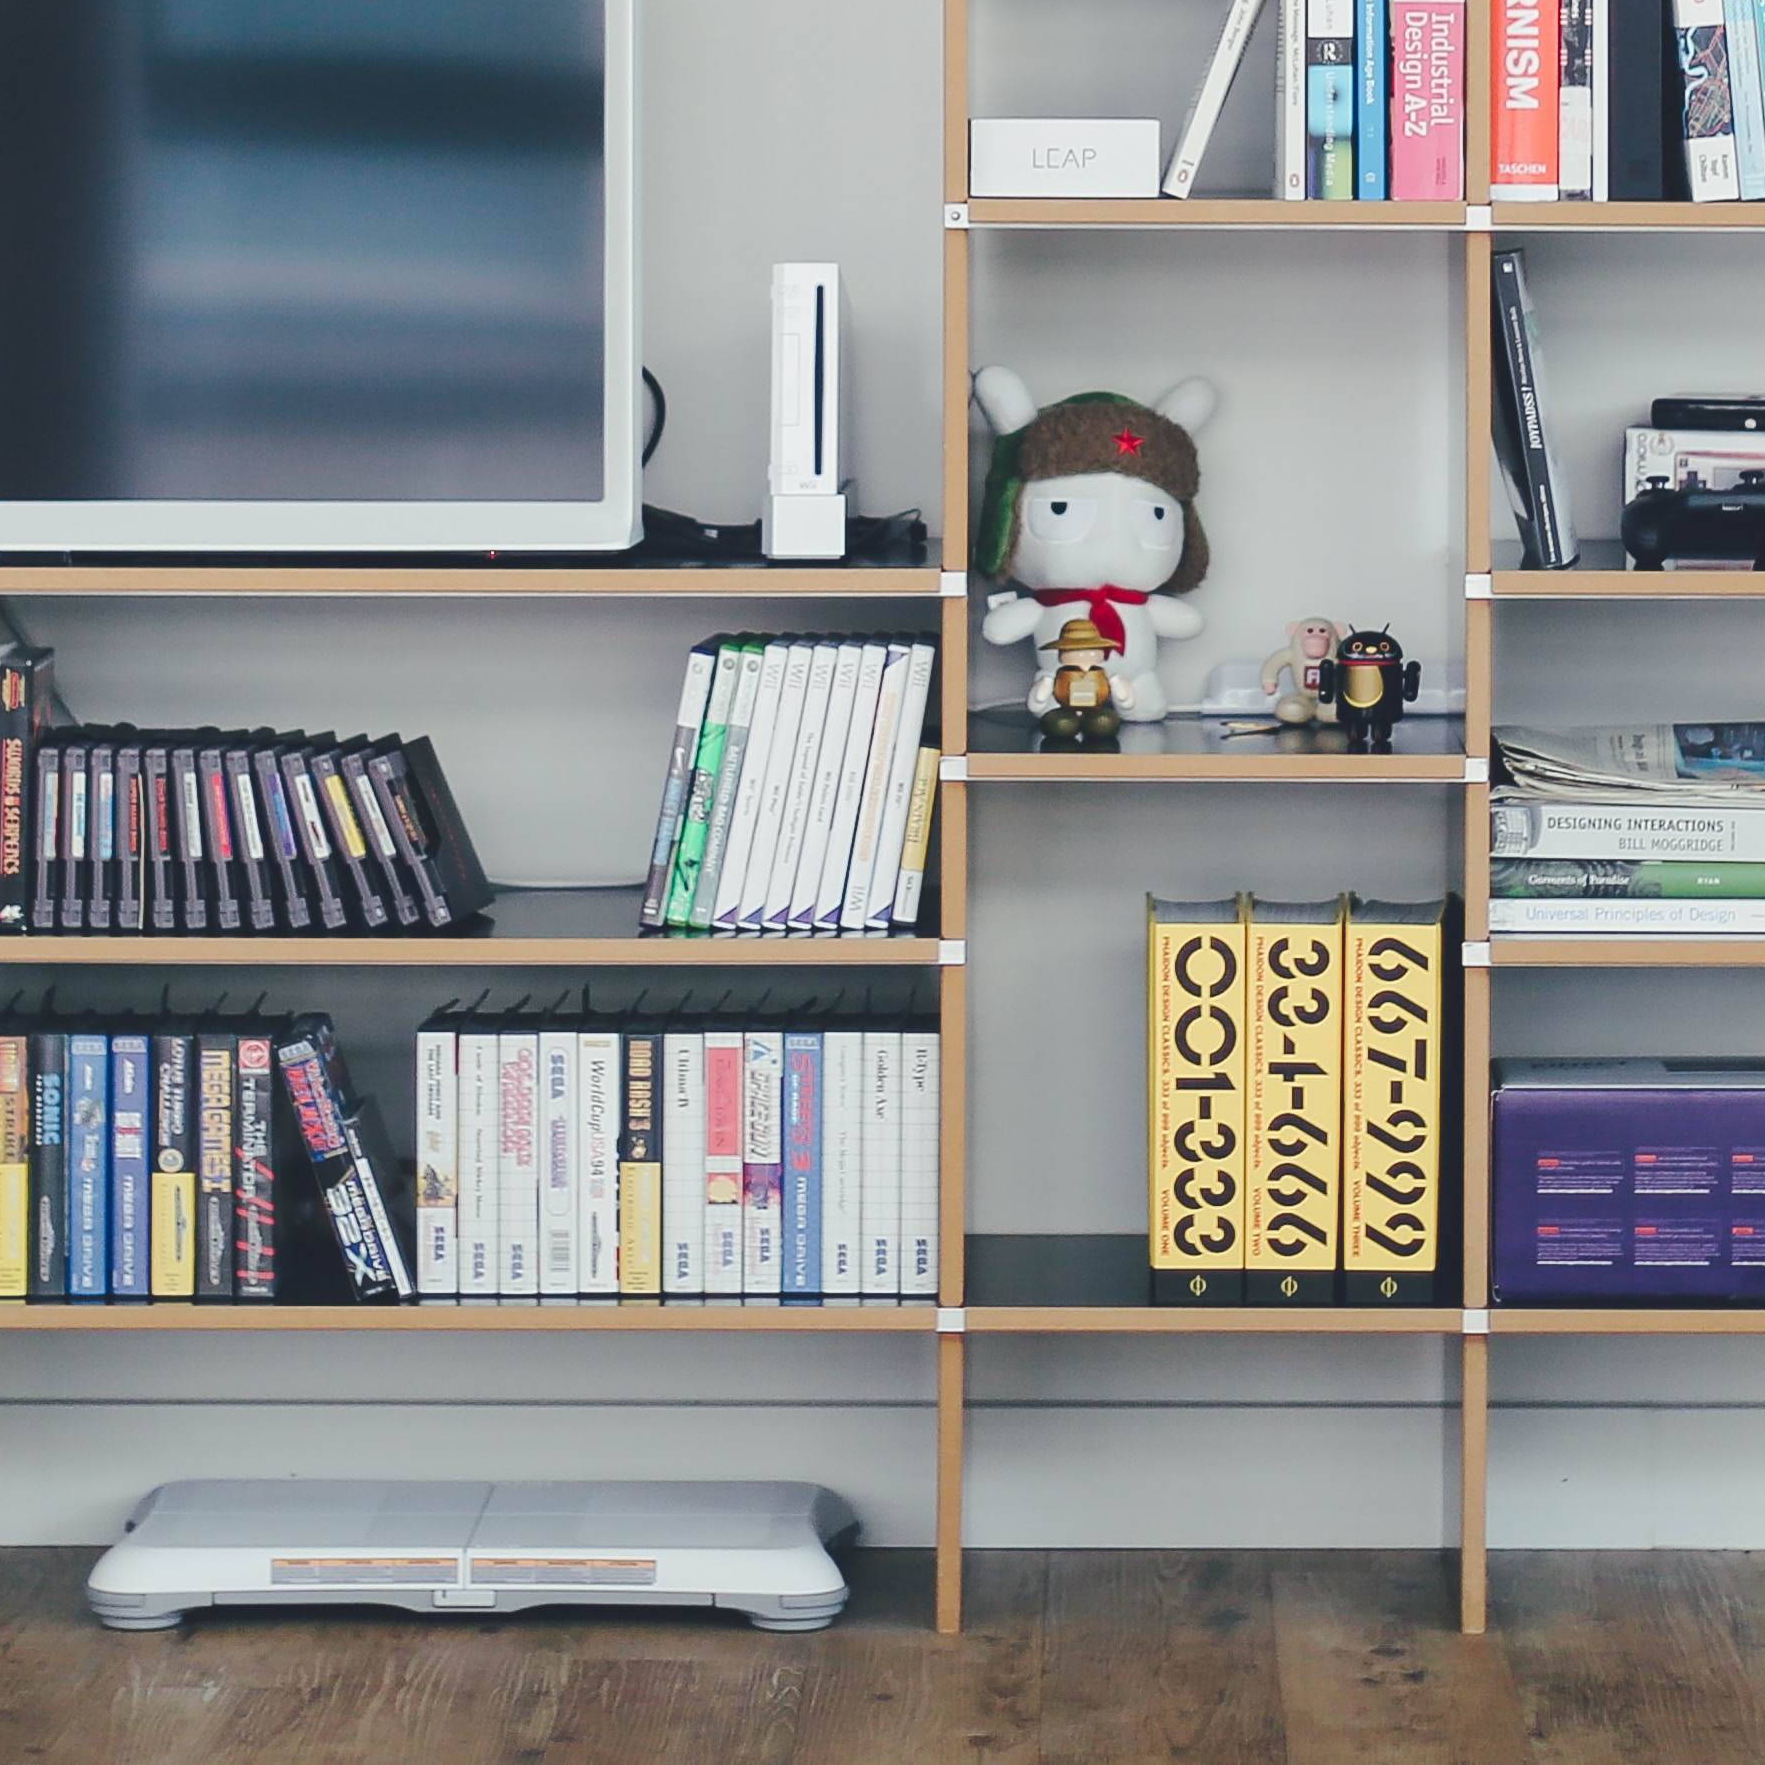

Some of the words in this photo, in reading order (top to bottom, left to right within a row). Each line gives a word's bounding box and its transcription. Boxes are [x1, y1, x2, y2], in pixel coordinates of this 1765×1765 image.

[1364, 3, 1375, 59] Information
[1398, 11, 1428, 89] Design
[1363, 60, 1375, 82] Age
[1365, 83, 1376, 105] Book
[1430, 12, 1456, 126] Industrial
[1403, 92, 1427, 138] A-Z
[1033, 148, 1097, 168] LEAP
[550, 1053, 565, 1099] SEGA
[1173, 936, 1237, 1257] 001-333
[1266, 937, 1330, 1257] 334-666
[1364, 937, 1429, 1257] 667-999
[41, 1073, 61, 1146] SONIC
[875, 1237, 887, 1276] SEGA
[915, 1237, 927, 1276] SEGA
